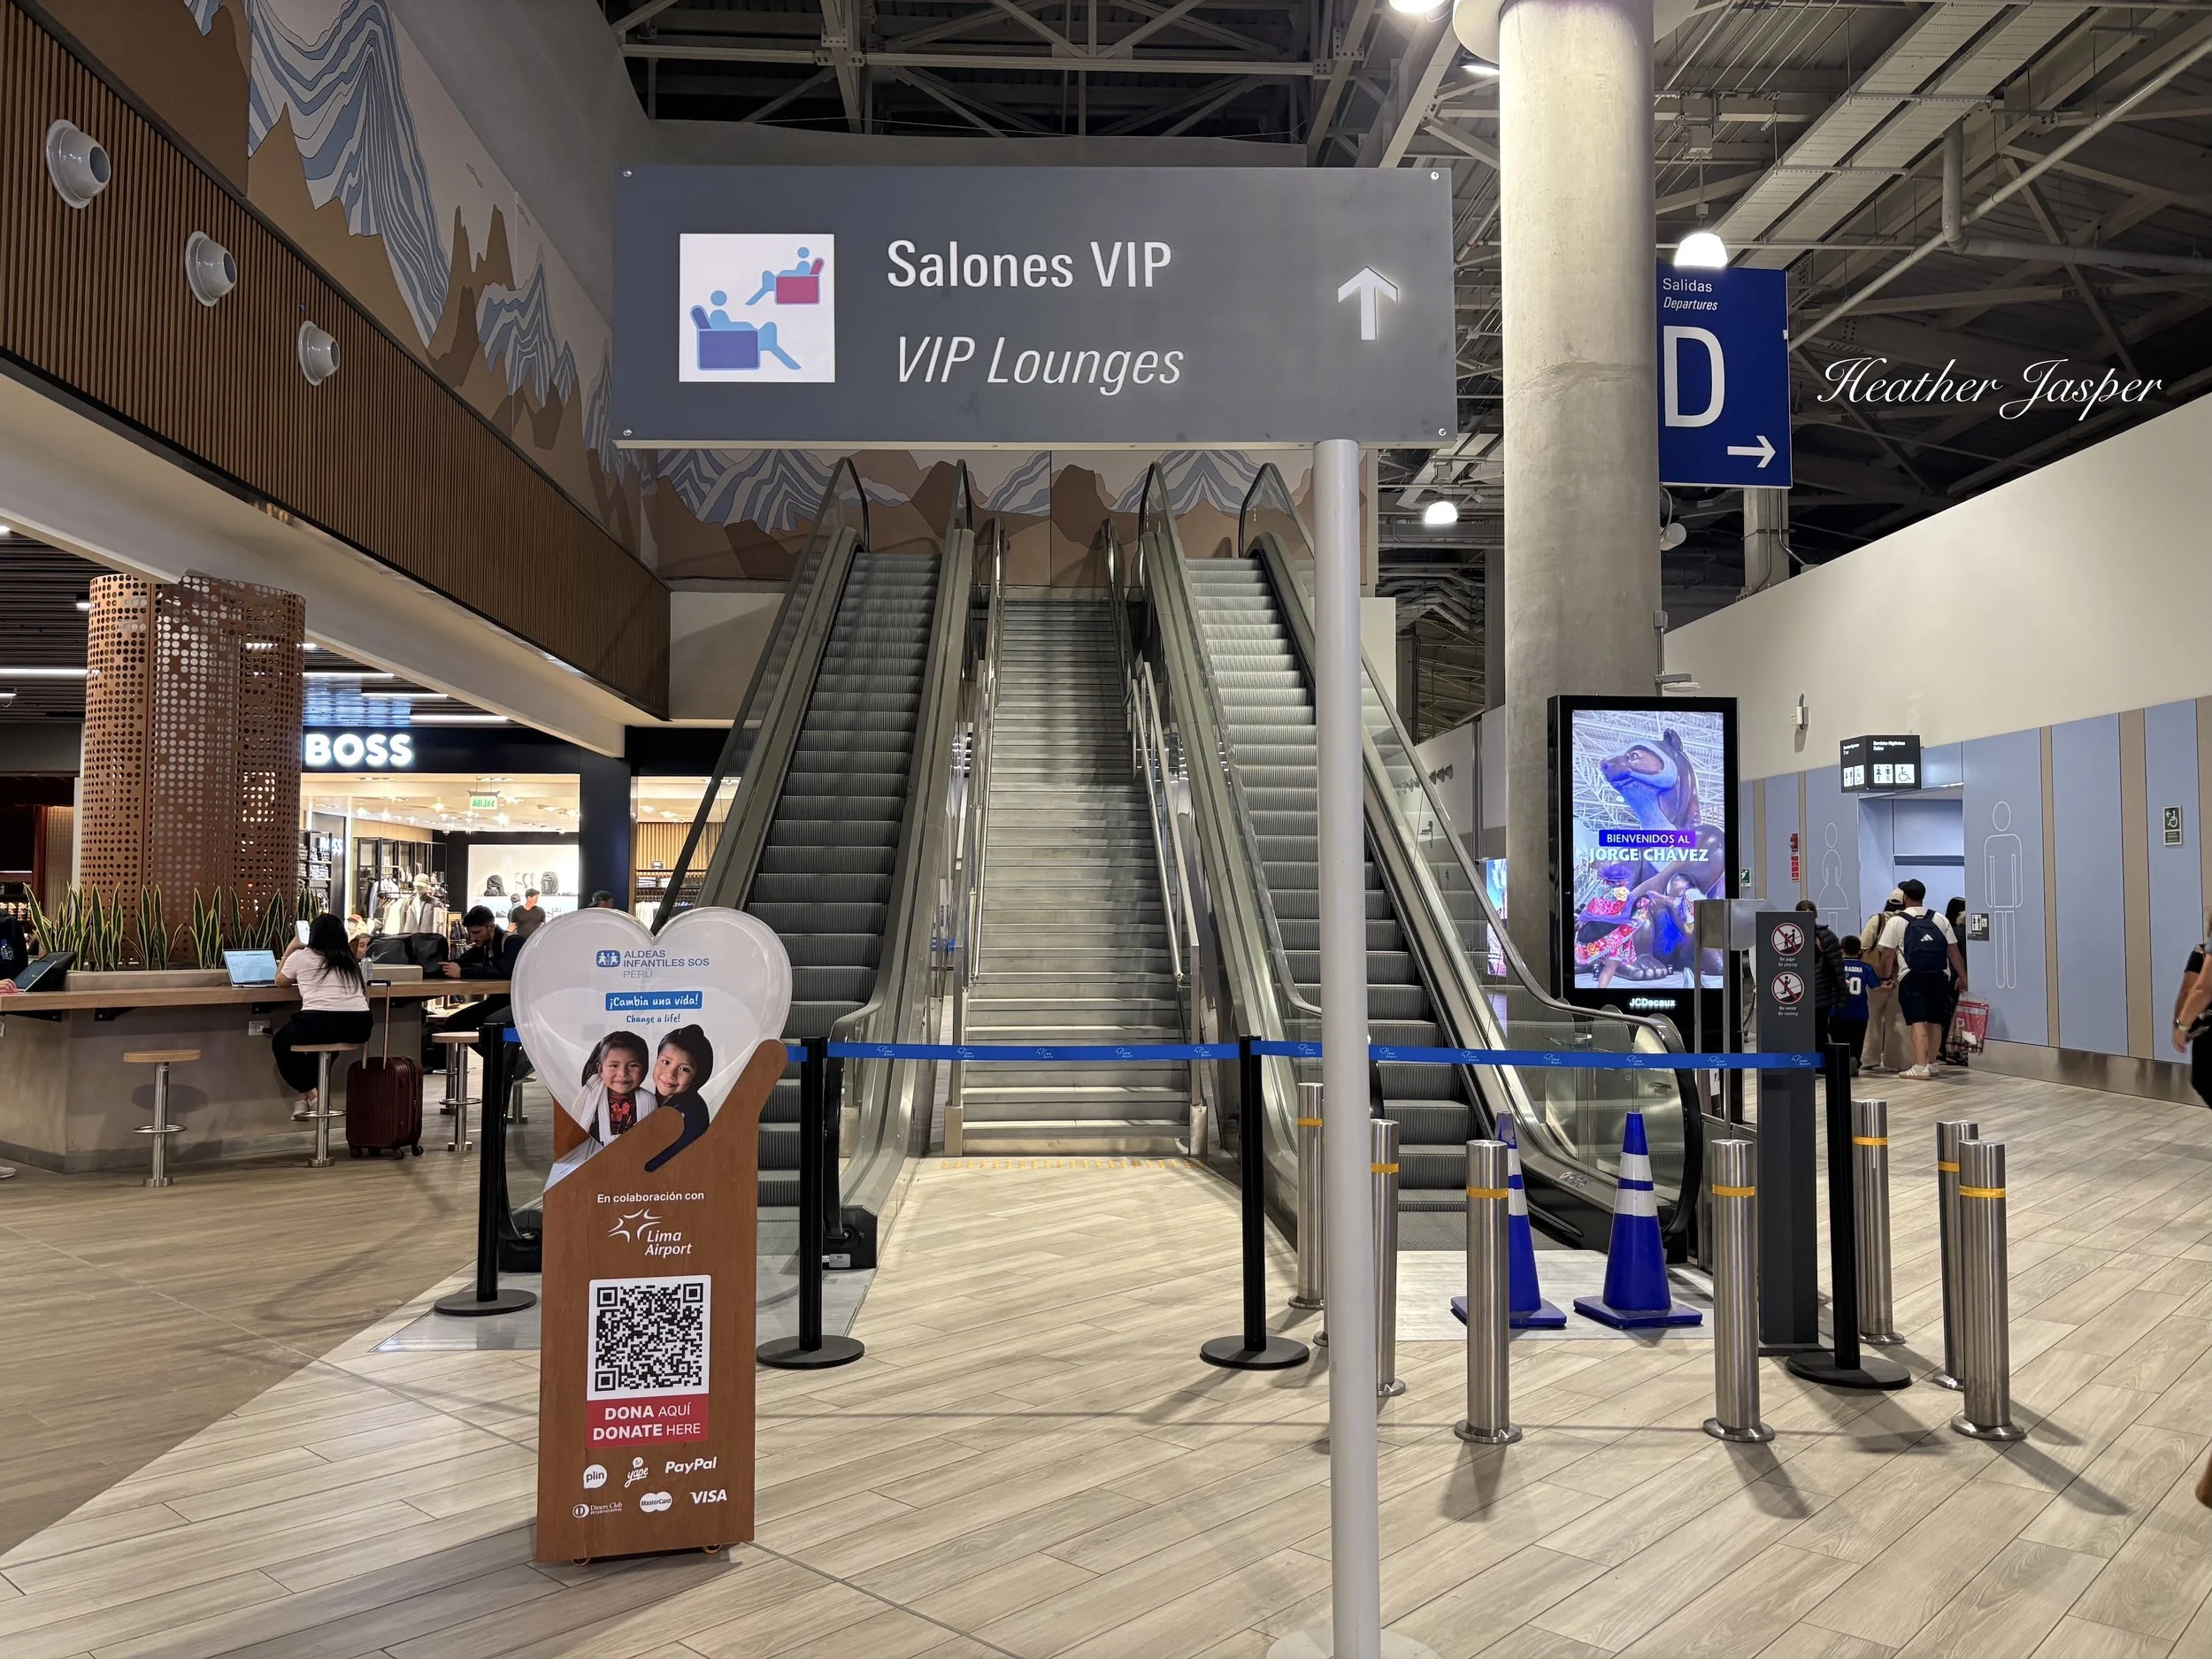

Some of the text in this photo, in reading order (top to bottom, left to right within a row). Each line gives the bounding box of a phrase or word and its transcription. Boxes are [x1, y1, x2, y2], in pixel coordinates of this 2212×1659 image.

[887, 240, 1172, 288] Salones VIP
[1663, 278, 1713, 292] Salidas
[1663, 296, 1718, 311] Departures
[897, 336, 1185, 396] VIP Lounges
[1663, 325, 1725, 427] D
[305, 733, 413, 766] BOSS
[1607, 833, 1691, 844] BIENVENIDOS AL
[1589, 846, 1709, 863] JORGE CHÁVEZ
[624, 949, 666, 958] ALDEAS
[623, 957, 710, 967] INFANTILES SOS
[623, 968, 653, 979] PERÚ
[610, 996, 649, 1010] ¡Cambia
[675, 994, 698, 1005] vida!
[1629, 998, 1676, 1007] JCDecaux
[626, 1014, 655, 1025] Change
[664, 1013, 680, 1023] life!
[597, 1191, 704, 1203] En colaboración con
[647, 1230, 682, 1243] Lima
[644, 1243, 693, 1258] Airport
[604, 1402, 692, 1421] DONA AQUÍ
[593, 1423, 702, 1441] DONATE HERE
[664, 1456, 718, 1474] PayPal
[586, 1471, 604, 1483] plin
[624, 1467, 649, 1488] yape
[689, 1489, 727, 1504] VISA
